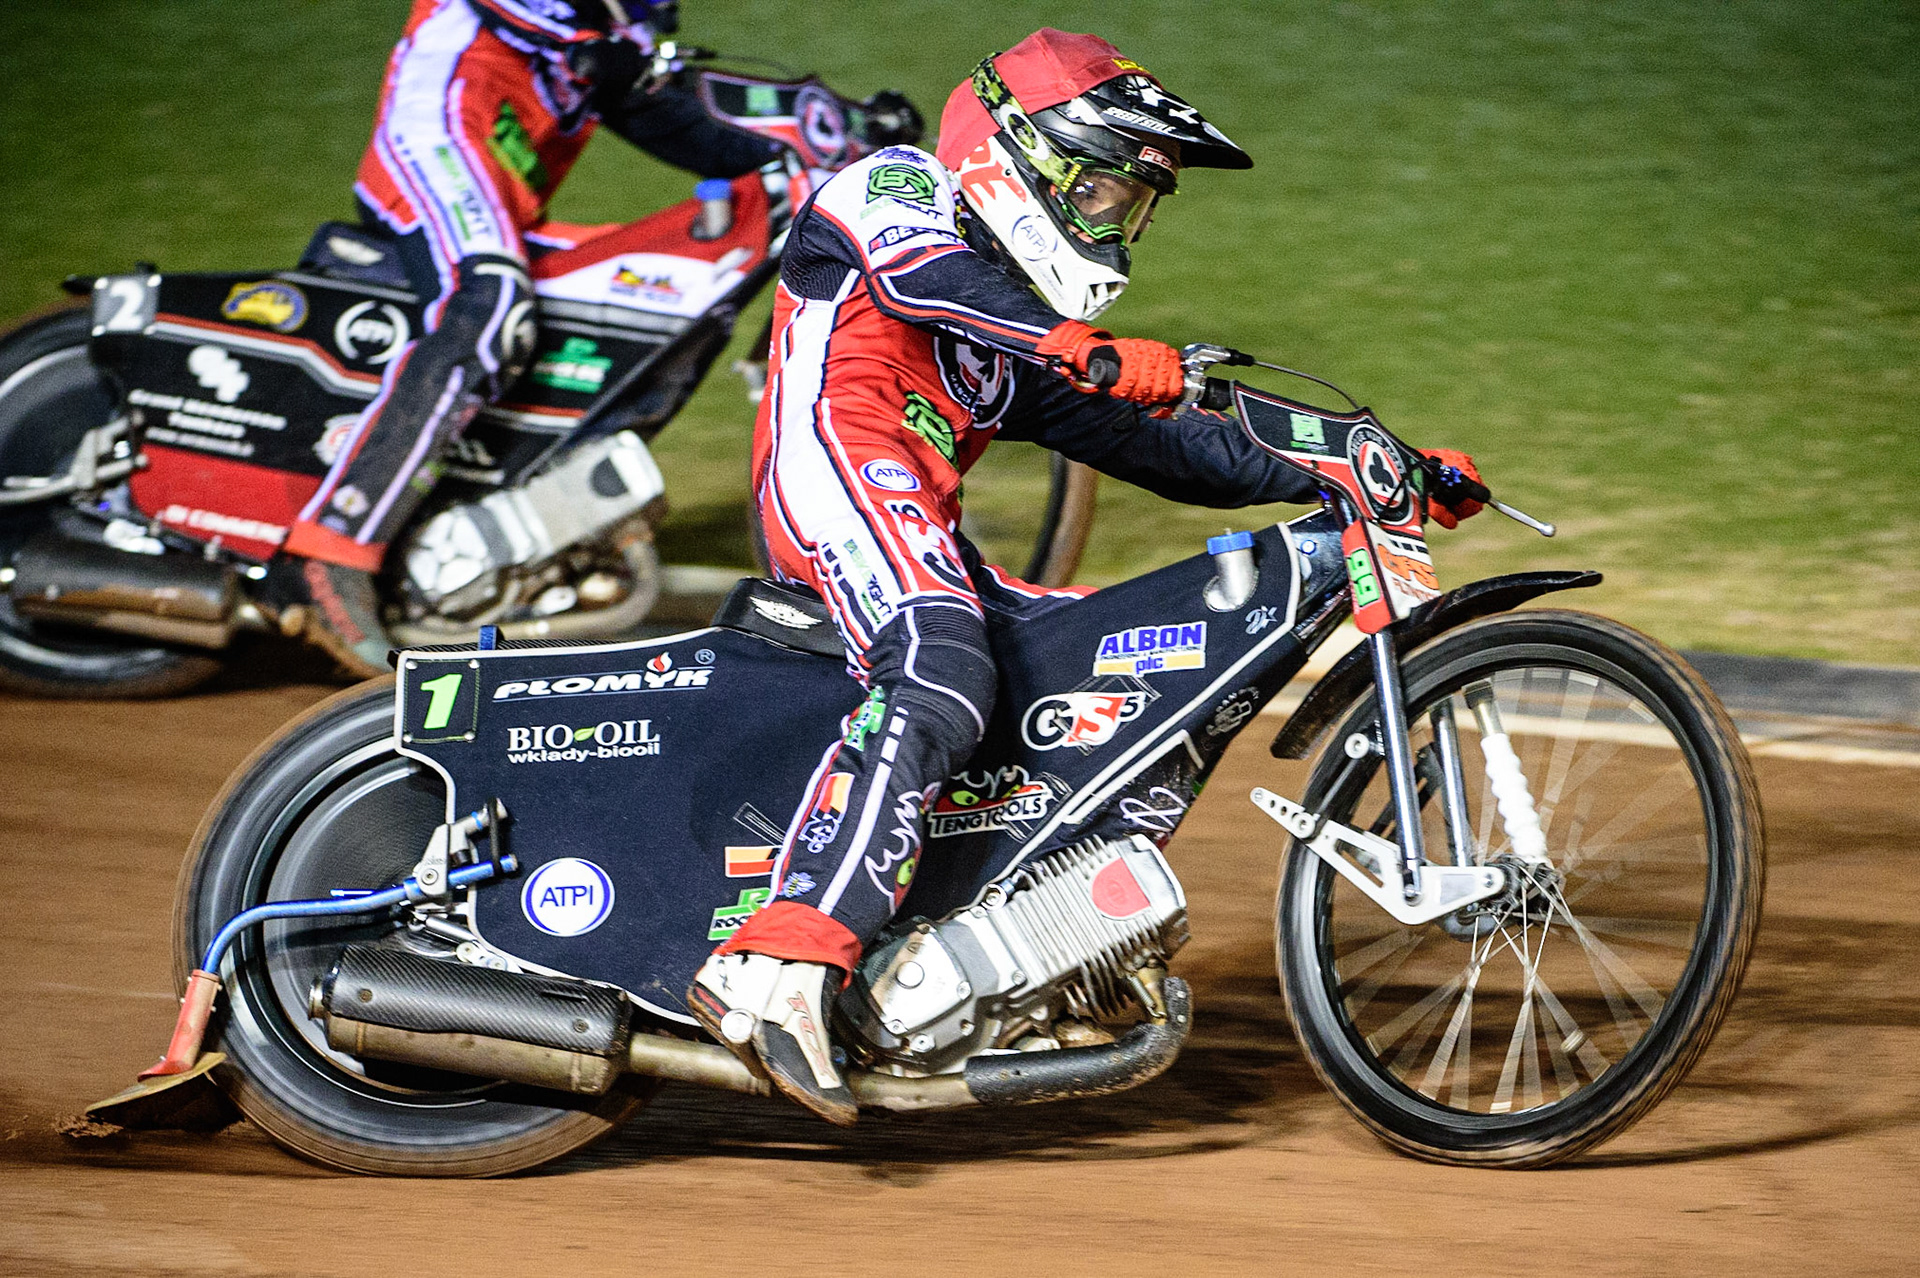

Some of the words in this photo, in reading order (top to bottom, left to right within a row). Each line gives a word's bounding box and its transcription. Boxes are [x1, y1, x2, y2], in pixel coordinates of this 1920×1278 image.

[107, 280, 143, 330] 2
[1101, 624, 1203, 656] ALBON
[1136, 656, 1164, 675] plc
[420, 673, 463, 729] 1
[540, 885, 594, 908] ATPI
